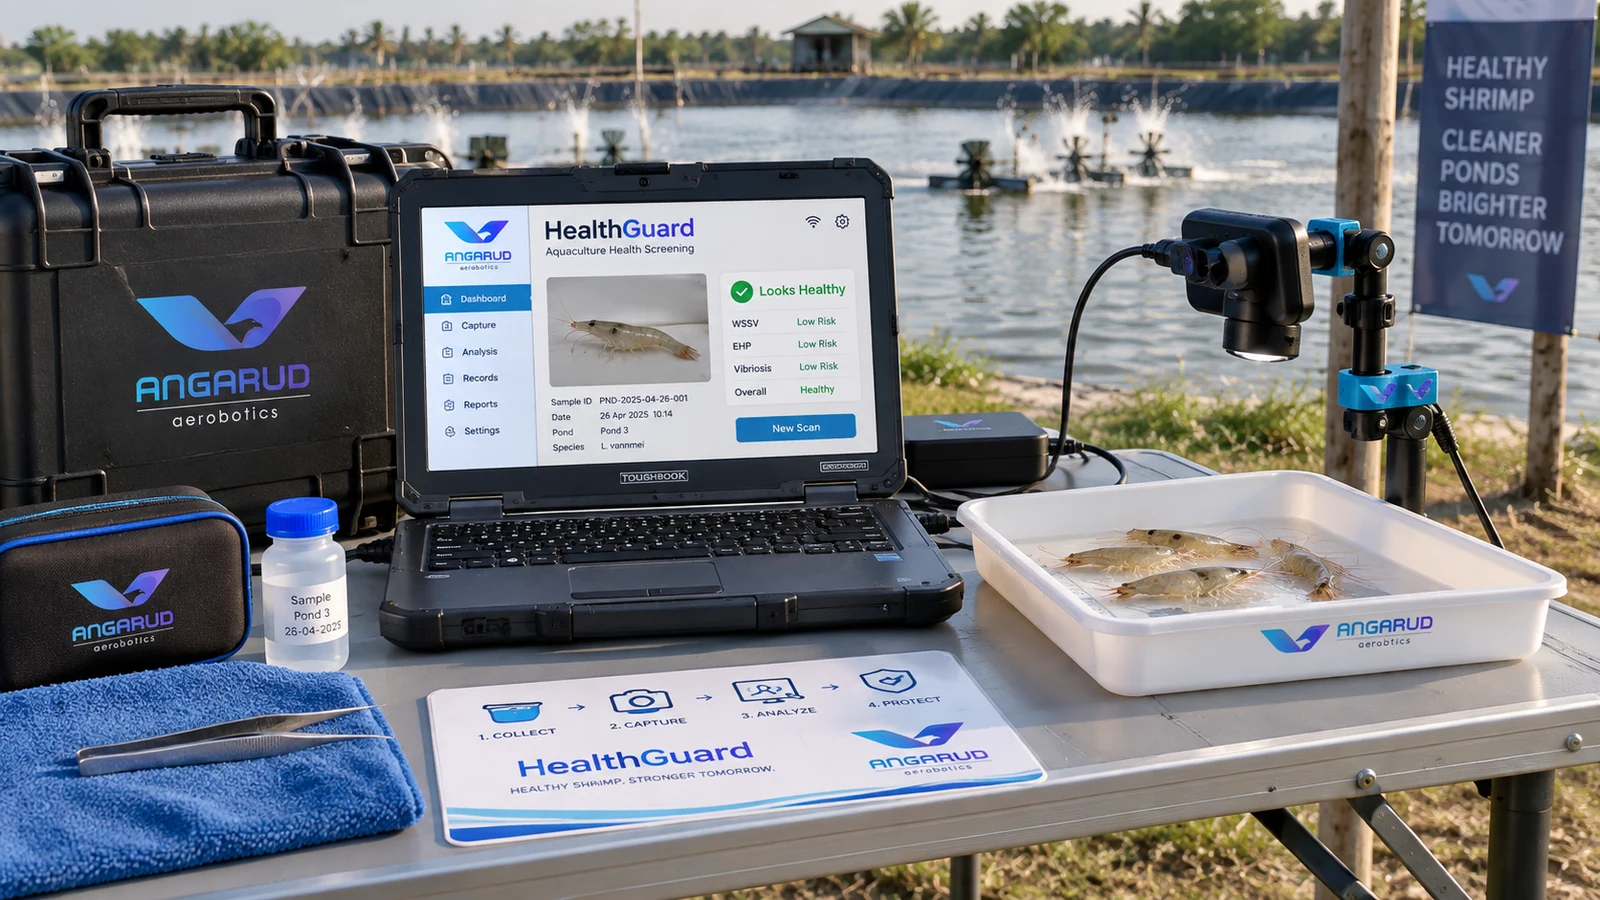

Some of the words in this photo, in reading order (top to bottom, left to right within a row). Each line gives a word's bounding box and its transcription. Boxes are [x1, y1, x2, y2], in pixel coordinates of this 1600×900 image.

[1446, 55, 1548, 81] HEALTHY
[1444, 87, 1535, 112] SHRIMP
[1441, 128, 1543, 156] CLEANER
[1440, 159, 1520, 186] PONDS
[1437, 190, 1548, 220] BRIGHTER
[545, 218, 695, 240] HealthGuard
[1436, 221, 1564, 255] TOMORROW
[545, 246, 606, 257] Aquaculture
[609, 244, 642, 254] Health
[644, 243, 695, 255] Screening
[445, 251, 512, 262] ANGARUD
[759, 285, 796, 297] Looks
[799, 283, 846, 297] Healthy
[460, 294, 507, 303] Dashboard
[461, 321, 497, 331] Capture
[732, 319, 760, 328] WSSV
[797, 317, 815, 326] Low
[817, 316, 837, 326] Risk
[732, 342, 752, 351] EHP
[798, 340, 816, 349] Low
[818, 339, 838, 349] Risk
[462, 347, 498, 357] Analysis
[734, 364, 772, 374] Vibriosis
[799, 363, 817, 371] Low
[820, 361, 839, 371] Risk
[136, 363, 310, 403] ANGARUD
[463, 373, 499, 382] Records
[734, 387, 767, 397] Overall
[800, 385, 835, 396] Healthy
[463, 400, 498, 410] Reports
[551, 398, 582, 407] Sample
[583, 397, 592, 405] ID
[599, 394, 688, 405] PND-2025-04-26-001
[172, 406, 279, 428] aerobotics
[551, 413, 571, 421] Date
[600, 411, 611, 420] 26
[612, 411, 626, 421] Apr
[628, 410, 649, 419] 2025
[464, 426, 500, 436] Settings
[552, 428, 574, 436] Pond
[600, 426, 622, 435] Pond
[623, 426, 629, 434] 3
[772, 424, 794, 433] New
[796, 422, 821, 432] Scan
[552, 442, 585, 453] Species
[601, 442, 608, 450] L.
[622, 472, 686, 483] TOUGHBOOK
[291, 592, 331, 606] Sample
[294, 609, 322, 621] Pond
[324, 607, 331, 618] 3
[71, 610, 175, 643] ANGARUD
[1337, 616, 1433, 637] ANGARUD
[93, 635, 156, 653] aerobotics
[868, 700, 880, 709] 4.
[882, 696, 941, 707] PROTECT
[741, 711, 754, 720] 3.
[757, 706, 817, 718] ANALYZE
[609, 722, 622, 730] 2.
[624, 717, 688, 729] CAPTURE
[493, 728, 557, 739] COLLECT
[517, 741, 754, 778] HealthGuard
[868, 750, 989, 771] ANGARUD
[904, 764, 972, 776] aerobotics
[510, 783, 569, 795] HEALTHY
[628, 771, 696, 785] STRONGER
[698, 765, 776, 778] TOMORROW.
